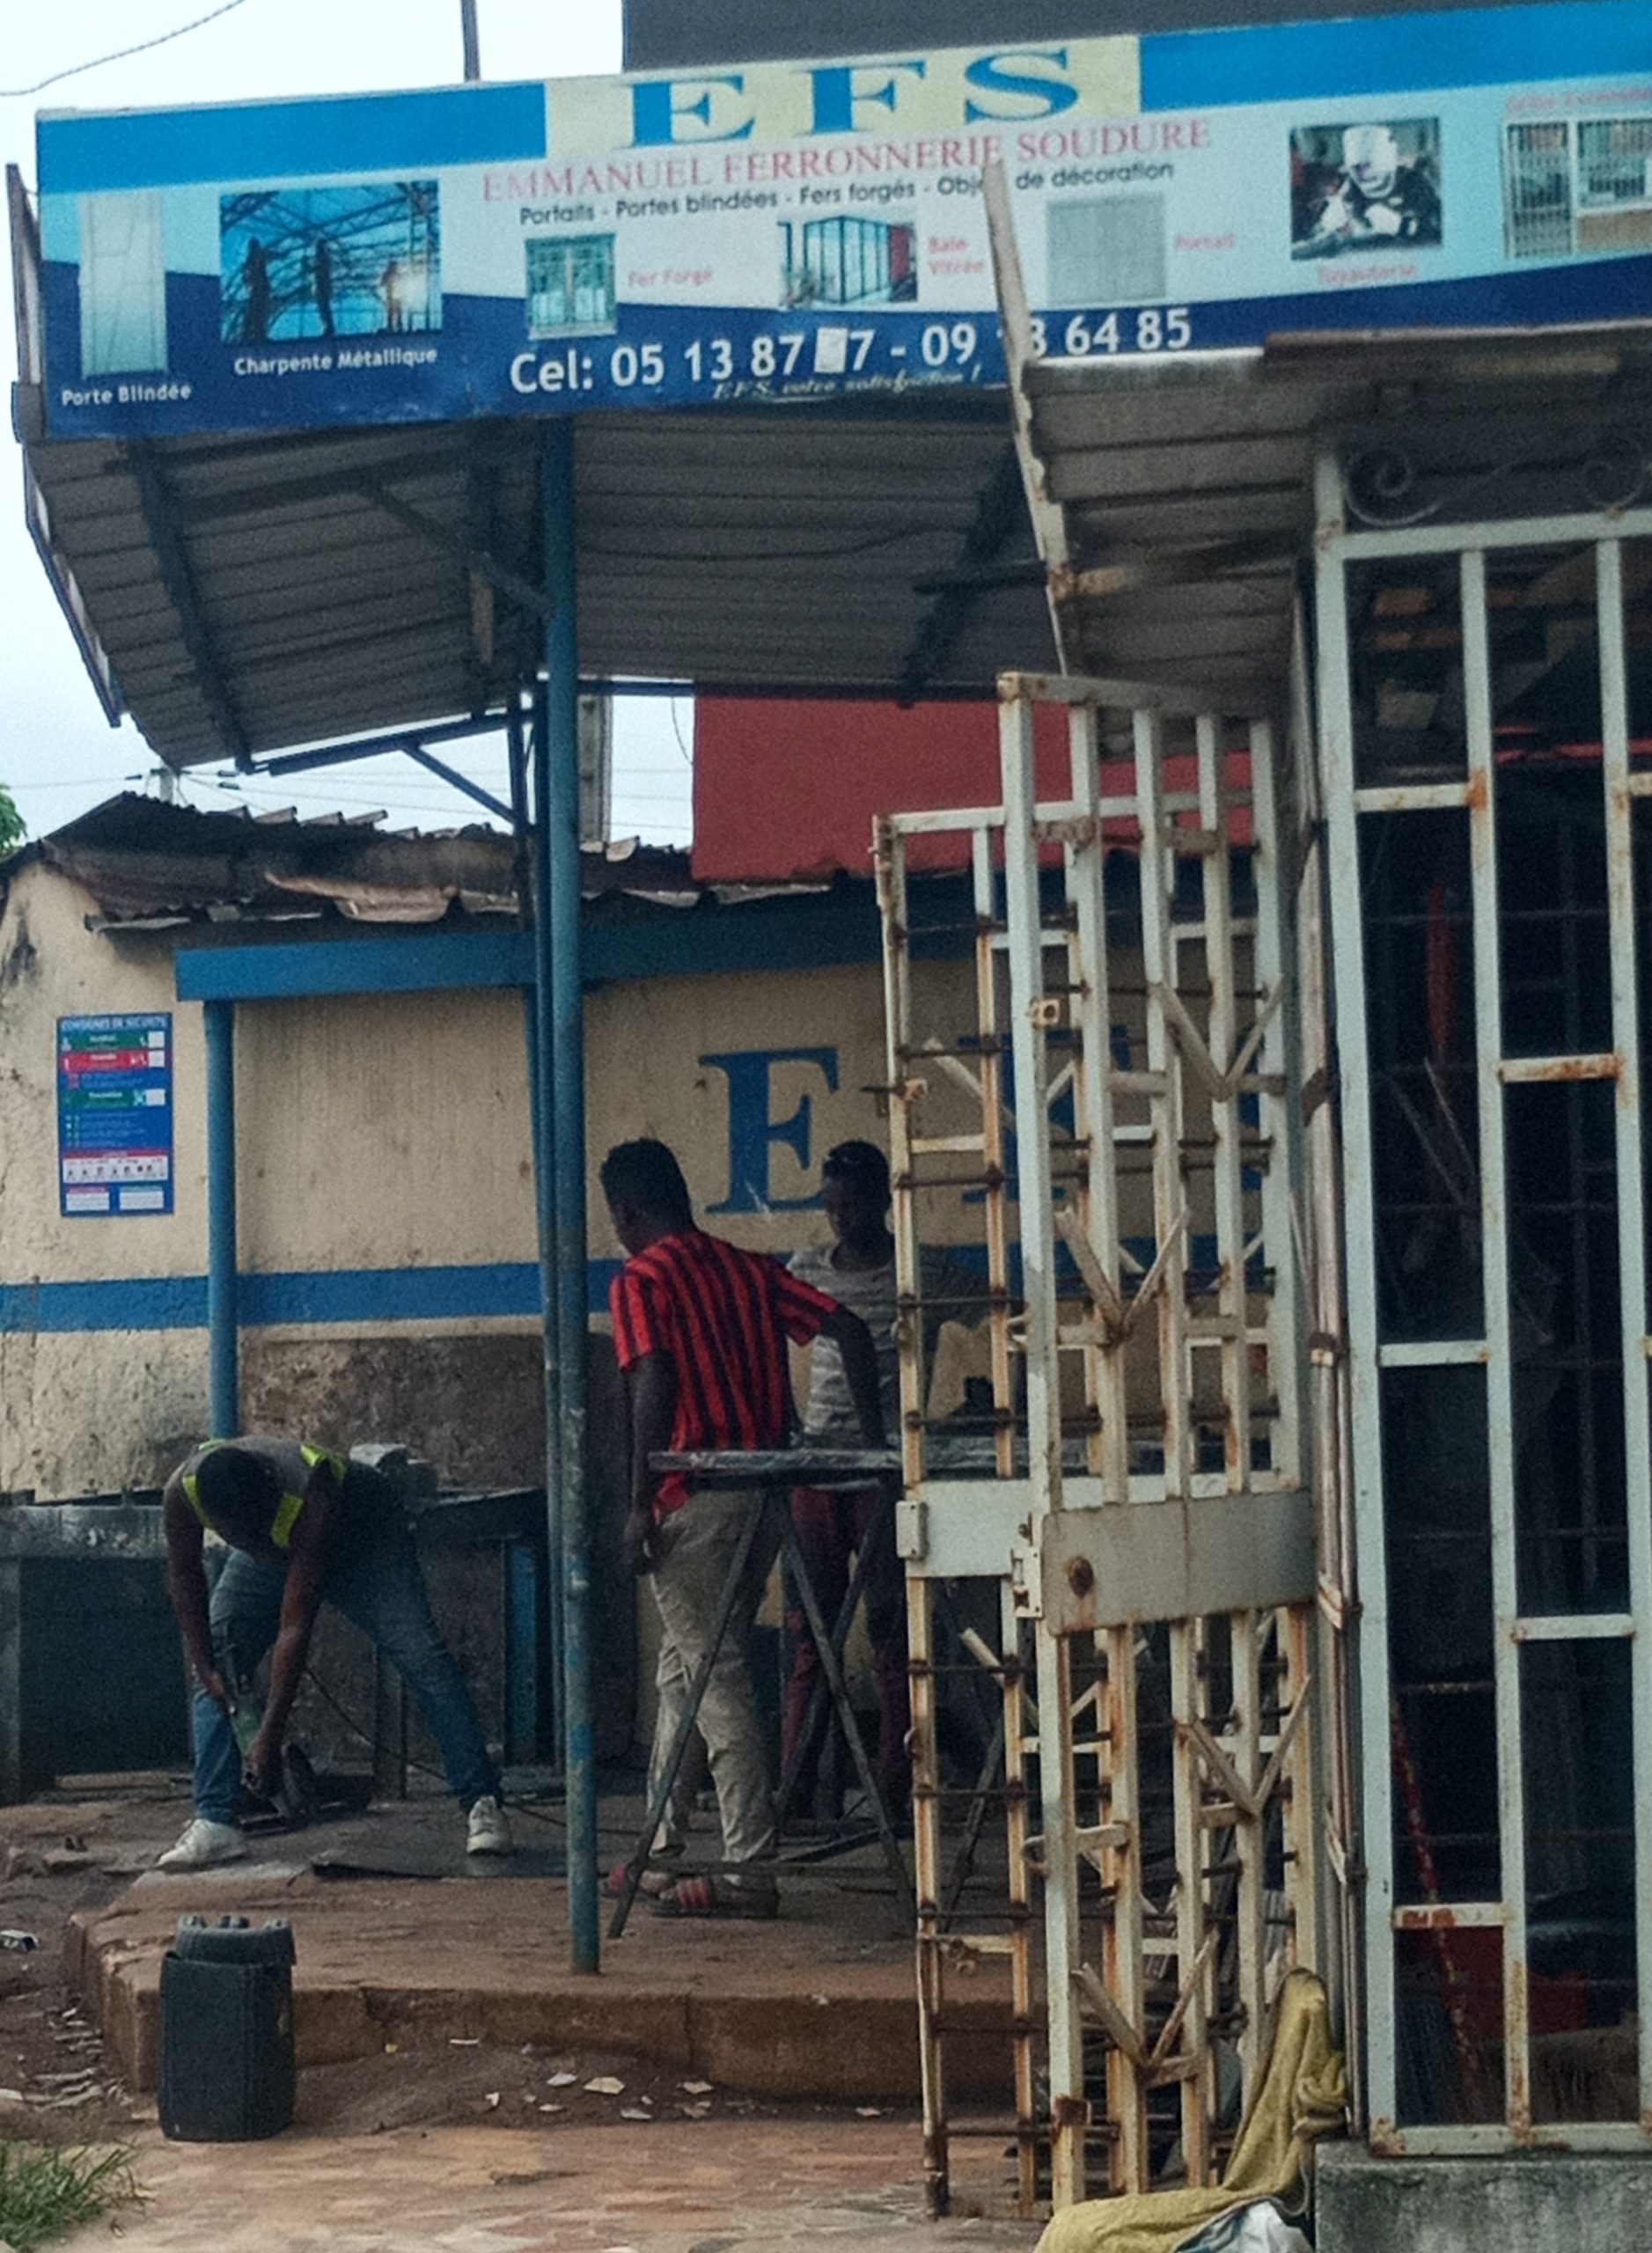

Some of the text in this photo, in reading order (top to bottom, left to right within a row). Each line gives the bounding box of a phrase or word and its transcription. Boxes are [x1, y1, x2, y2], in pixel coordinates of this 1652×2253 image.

[619, 48, 1079, 150] EFS
[482, 118, 1211, 202] EMMANUEL FERRONNERIE SOUDURE
[520, 202, 596, 225] Portails
[617, 196, 678, 218] Portes
[686, 190, 778, 213] blindées
[799, 185, 841, 205] Fers
[848, 181, 916, 205] forgés
[1015, 171, 1044, 190] de
[1051, 162, 1174, 187] décoration
[233, 347, 438, 376] Charpente Métallique
[510, 349, 592, 394] Cel:
[610, 342, 664, 387] 05
[684, 338, 733, 382] 13
[751, 334, 804, 377] 87
[921, 322, 977, 367] 09
[1064, 313, 1120, 356] 64
[1136, 307, 1192, 351] 85
[62, 383, 192, 406] Porte Blindée
